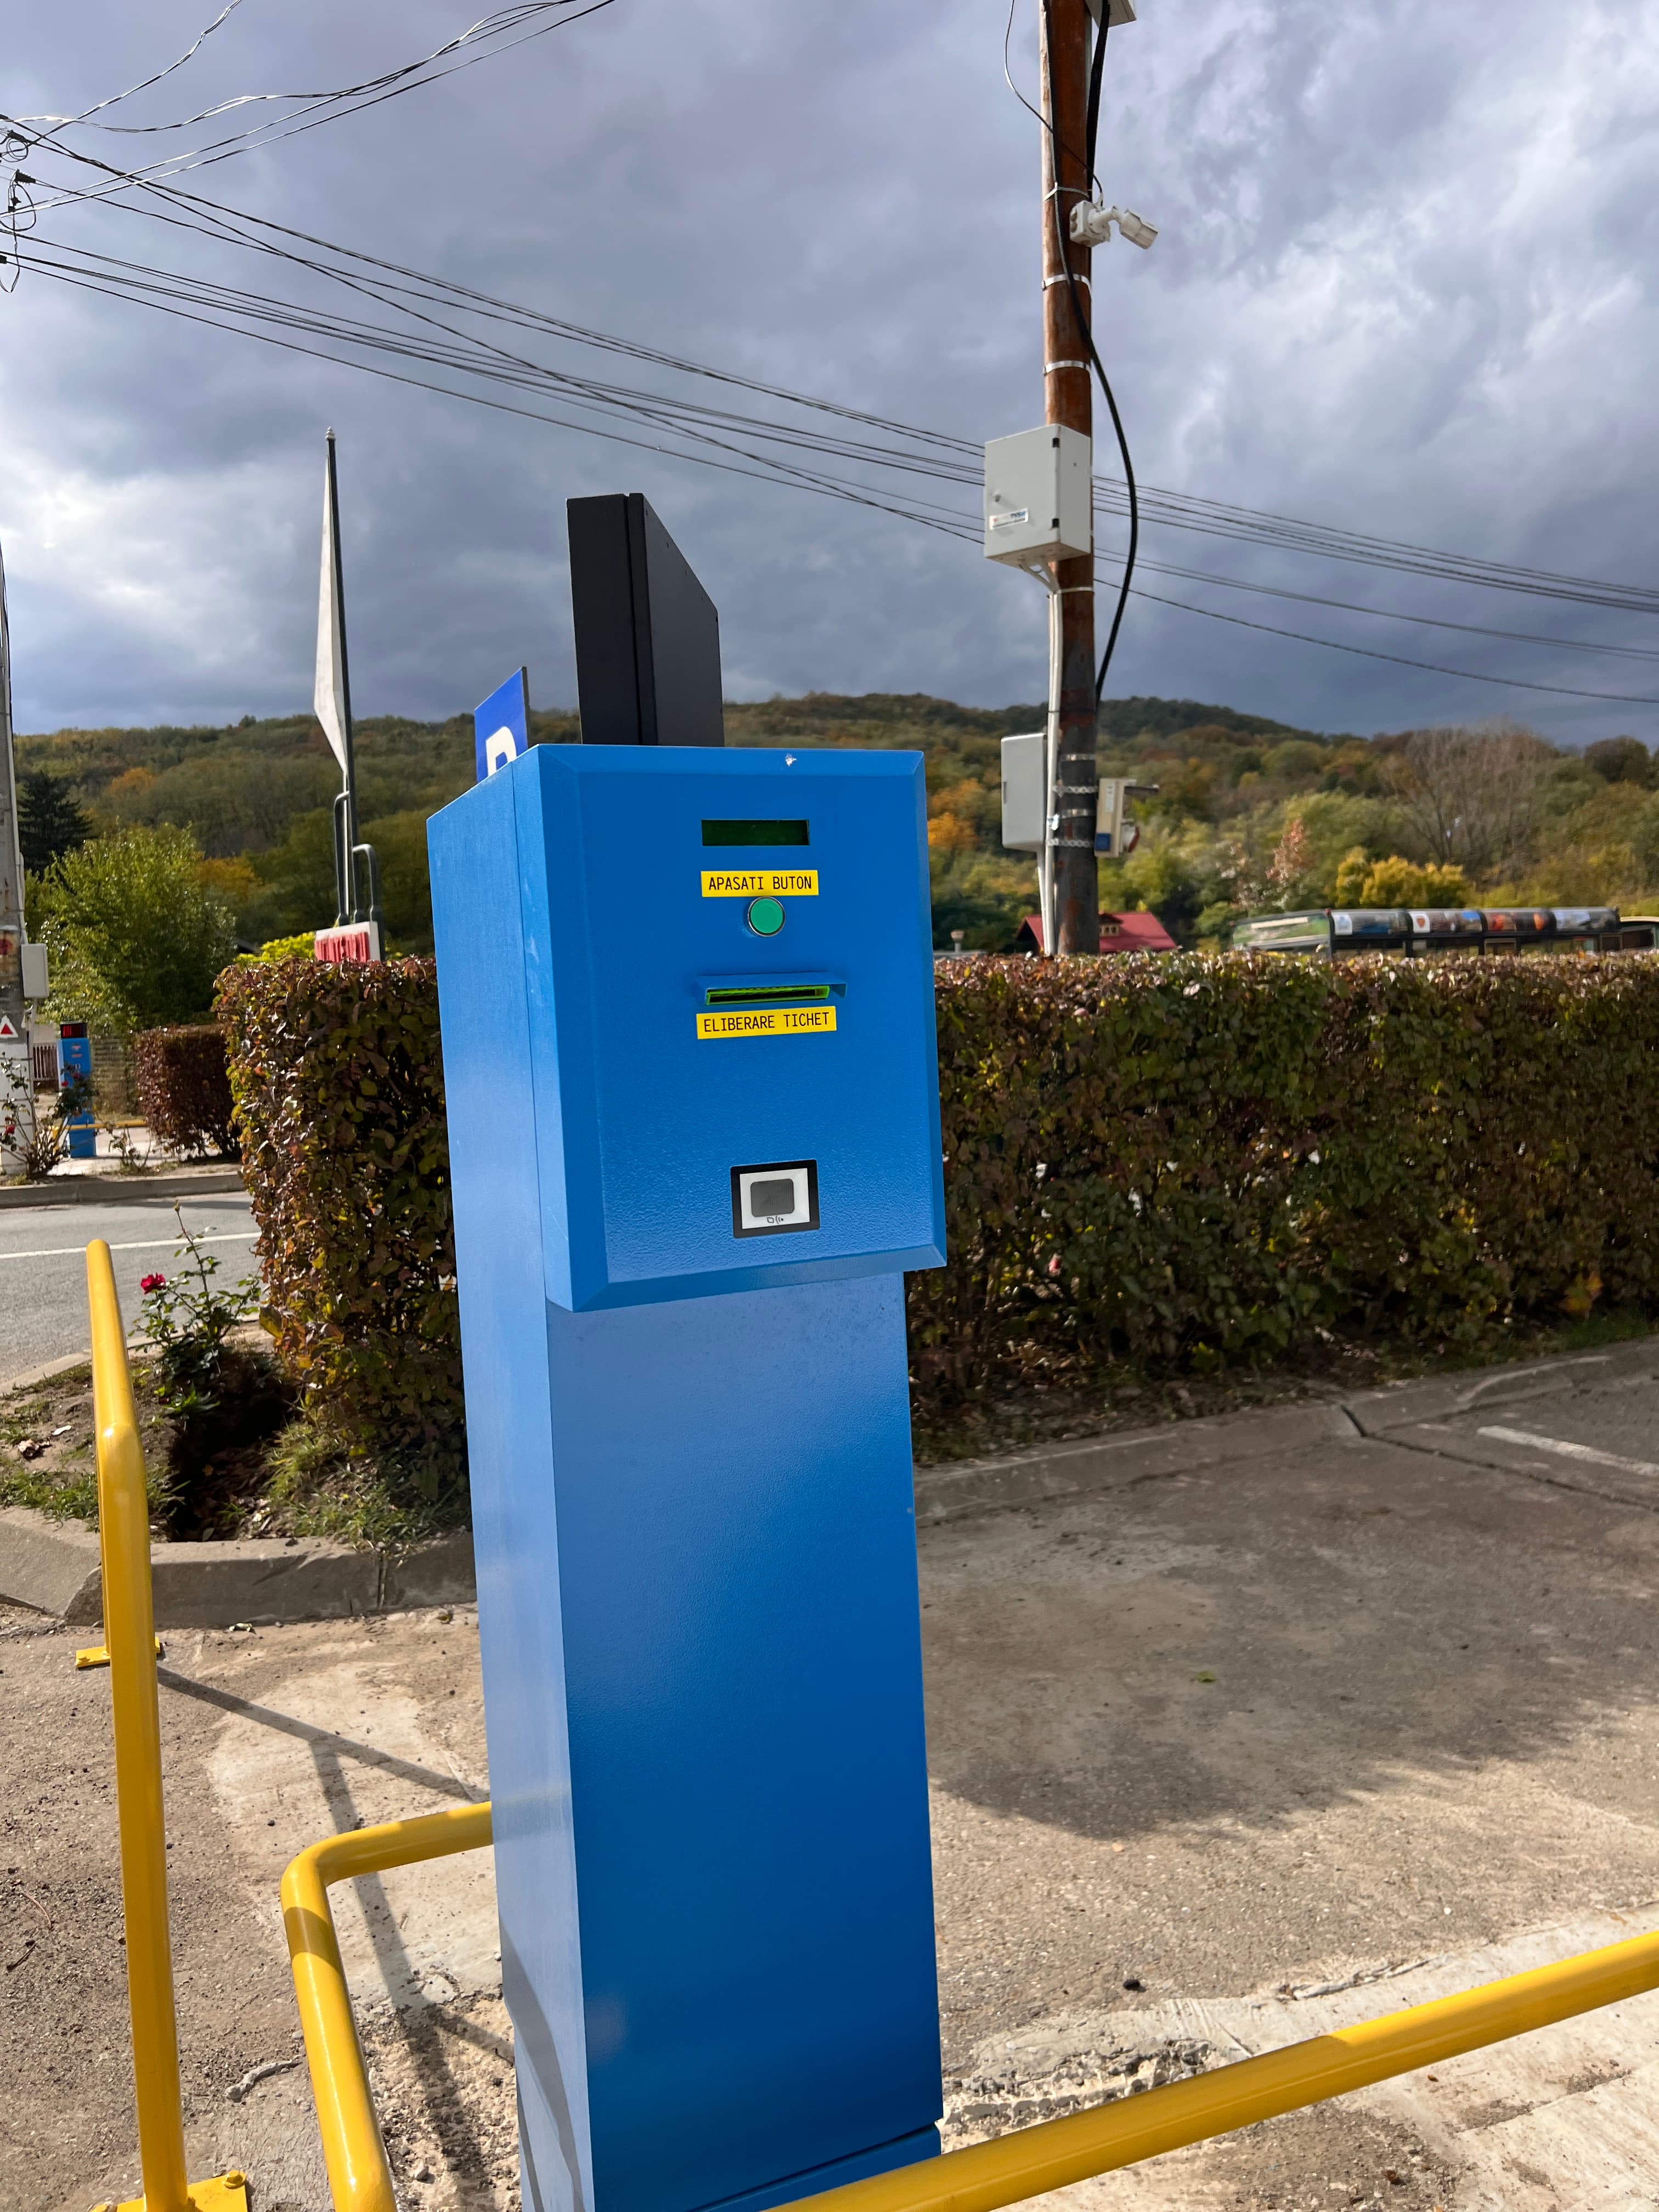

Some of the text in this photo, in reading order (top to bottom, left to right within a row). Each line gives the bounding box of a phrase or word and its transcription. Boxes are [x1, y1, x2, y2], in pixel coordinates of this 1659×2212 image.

[709, 876, 812, 890] APASATI BUTON
[704, 1012, 830, 1032] ELIBERARE TICHET
